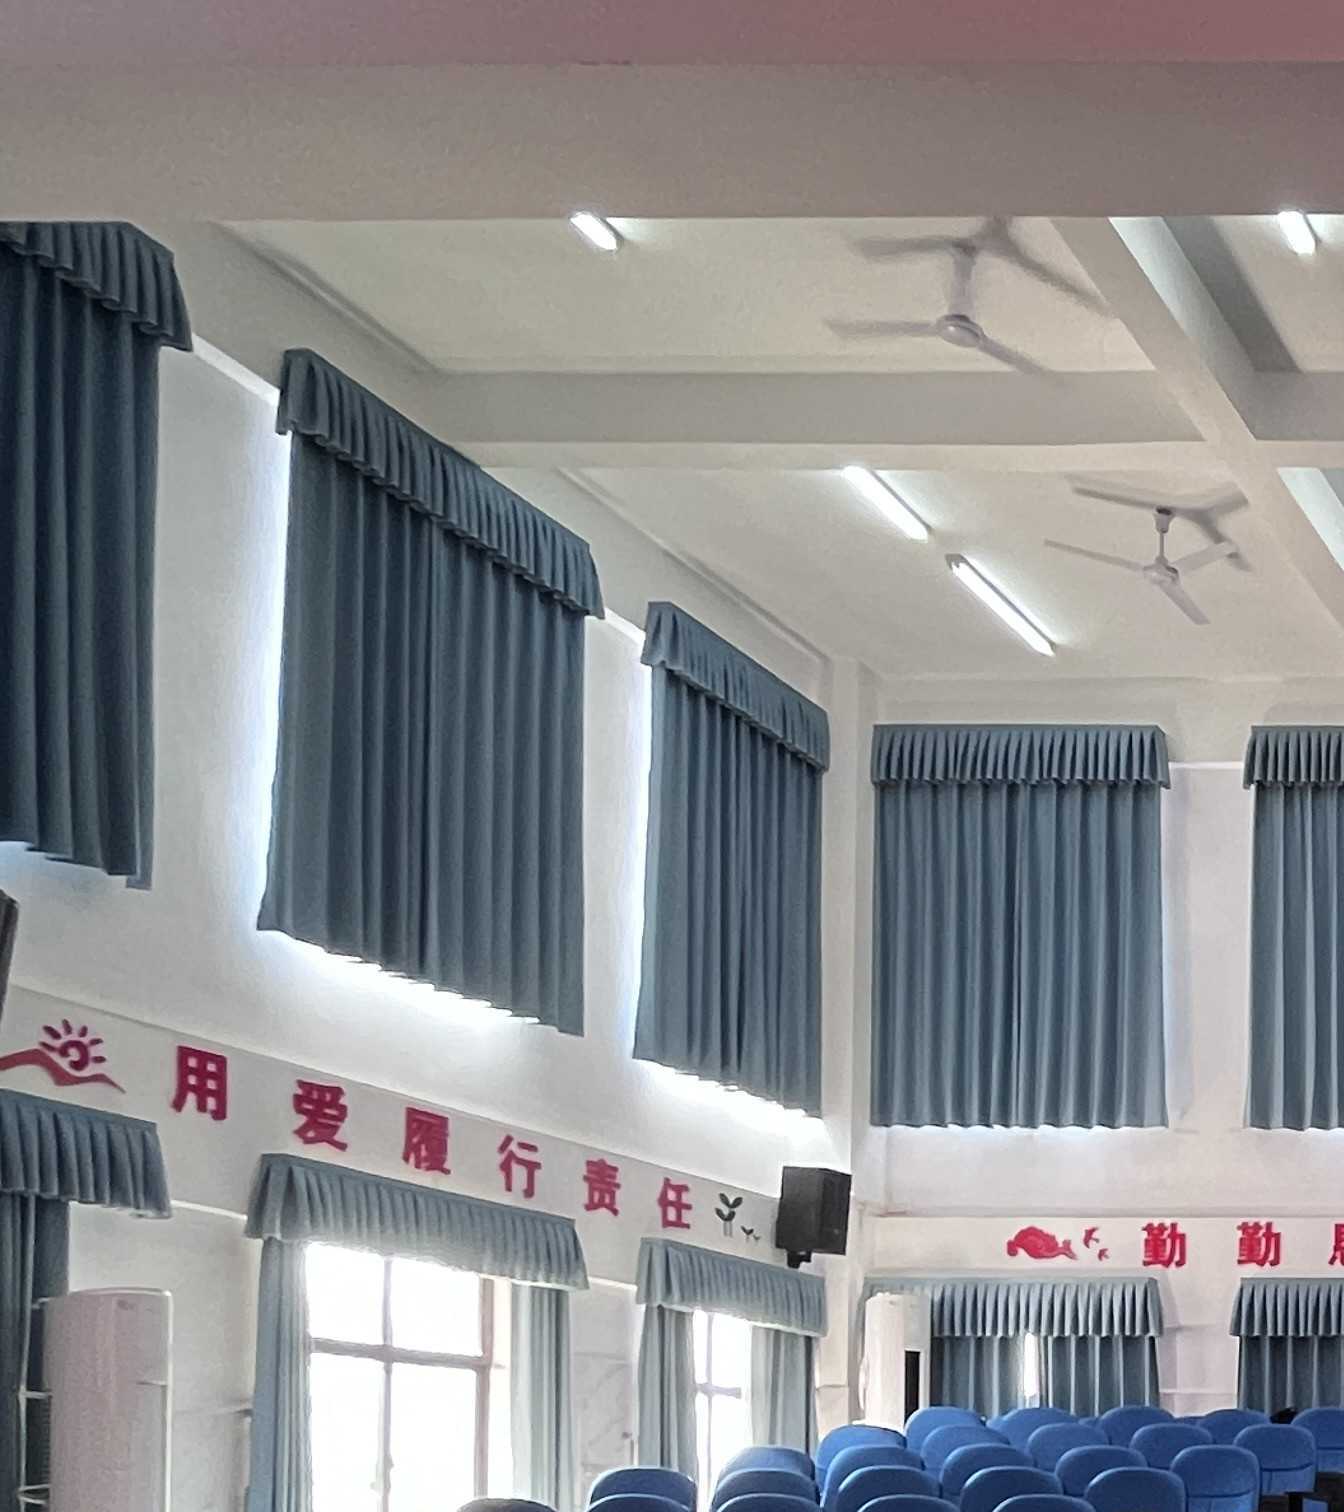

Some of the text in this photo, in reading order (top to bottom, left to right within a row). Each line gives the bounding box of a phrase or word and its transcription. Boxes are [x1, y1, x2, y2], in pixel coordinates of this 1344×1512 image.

[173, 1045, 694, 1230] 用爱履行责任
